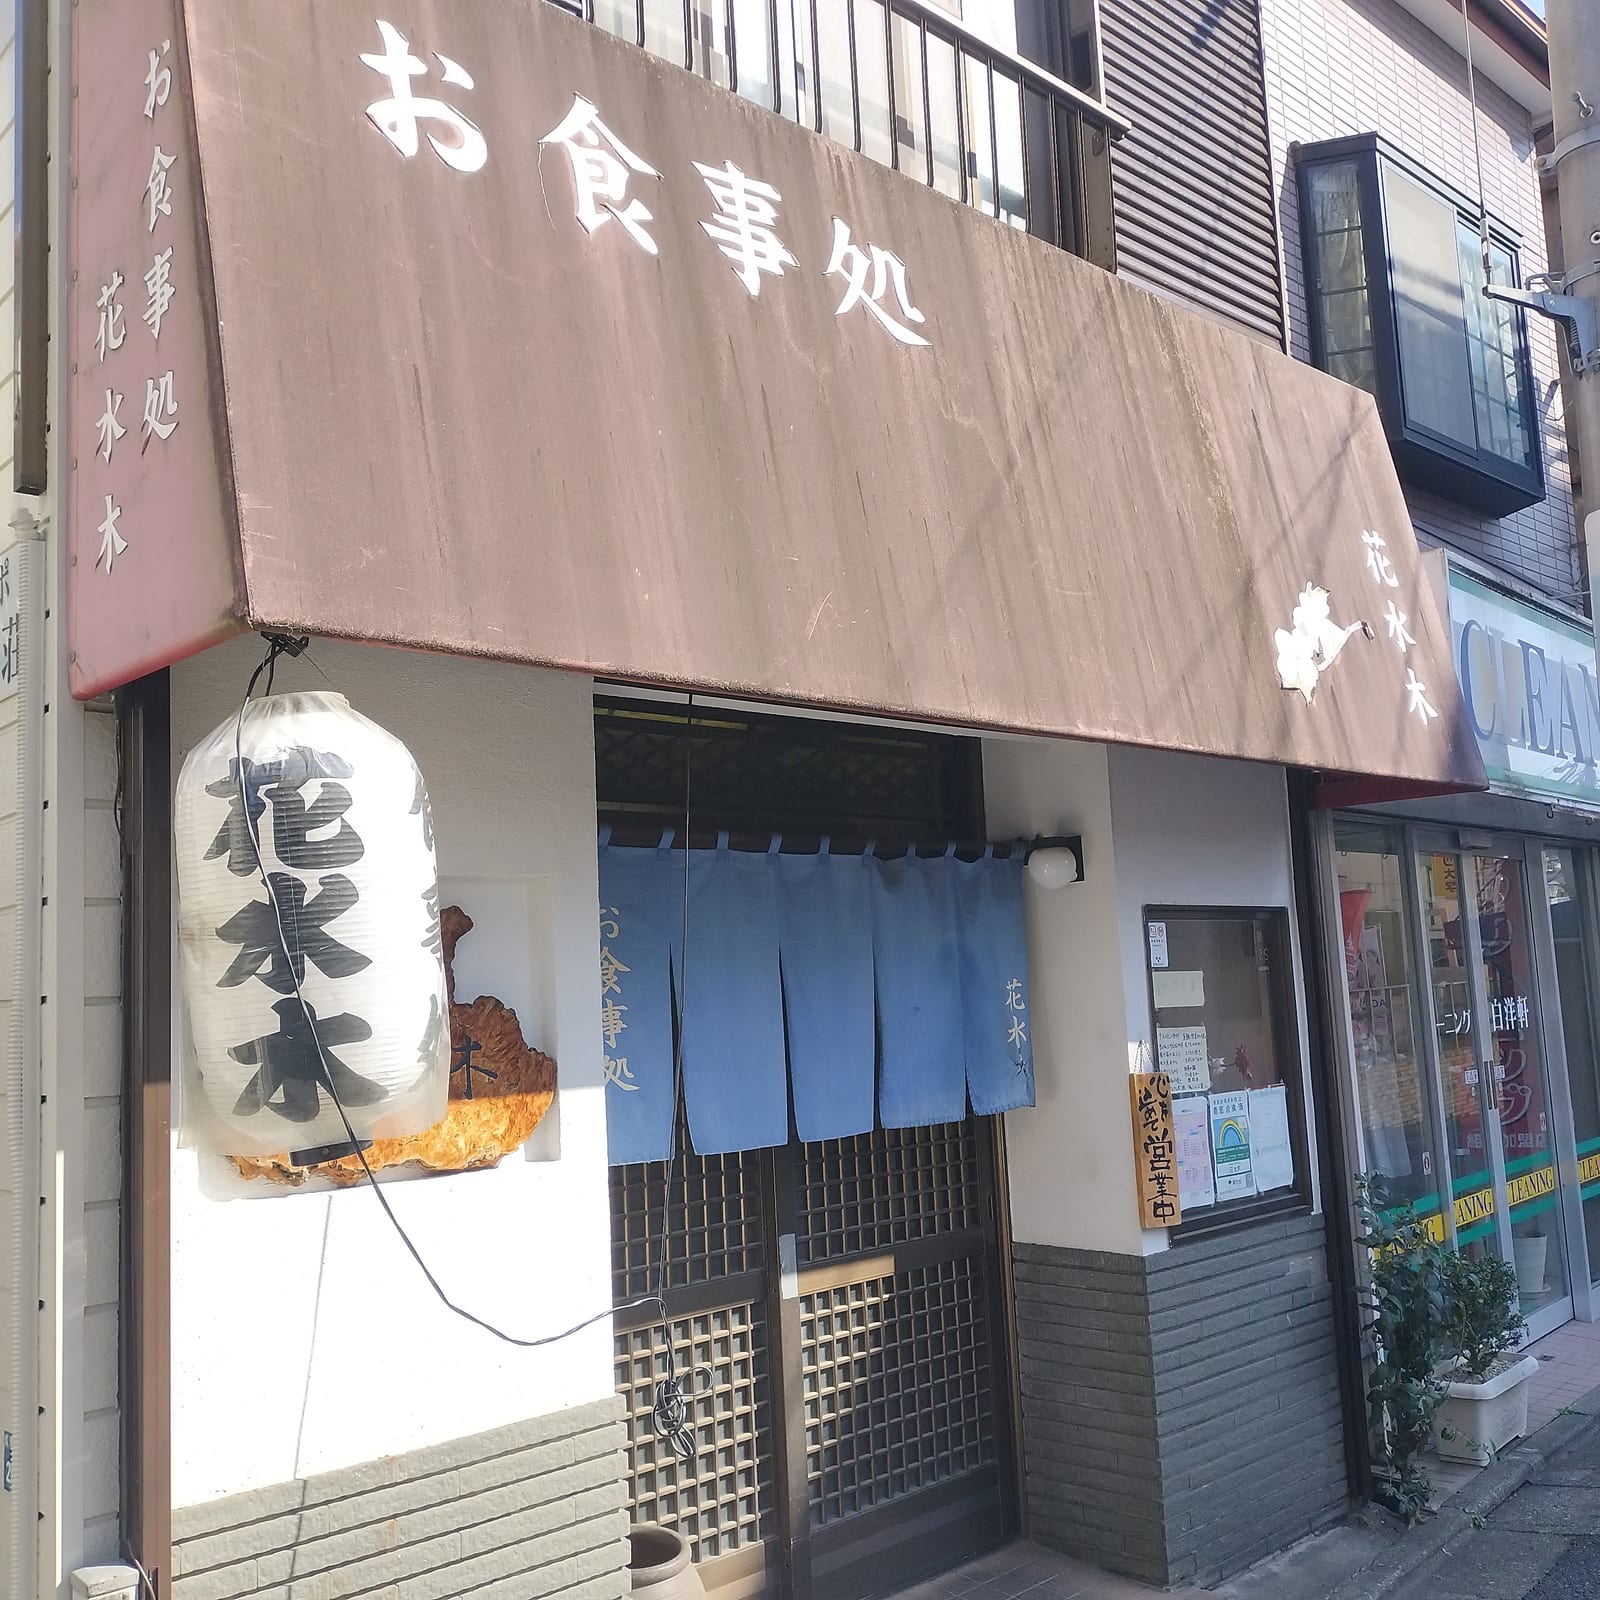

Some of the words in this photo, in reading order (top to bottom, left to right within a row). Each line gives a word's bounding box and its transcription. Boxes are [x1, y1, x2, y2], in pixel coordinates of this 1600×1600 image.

[143, 39, 179, 453] お食事処
[358, 18, 932, 346] お食事処
[94, 272, 127, 574] 花水木
[1361, 530, 1438, 725] 花水木
[202, 745, 389, 1122] 花水木
[1143, 1128, 1177, 1224] 営業中
[1455, 1191, 1492, 1224] ANING
[1467, 1132, 1547, 1149] 組加盟店
